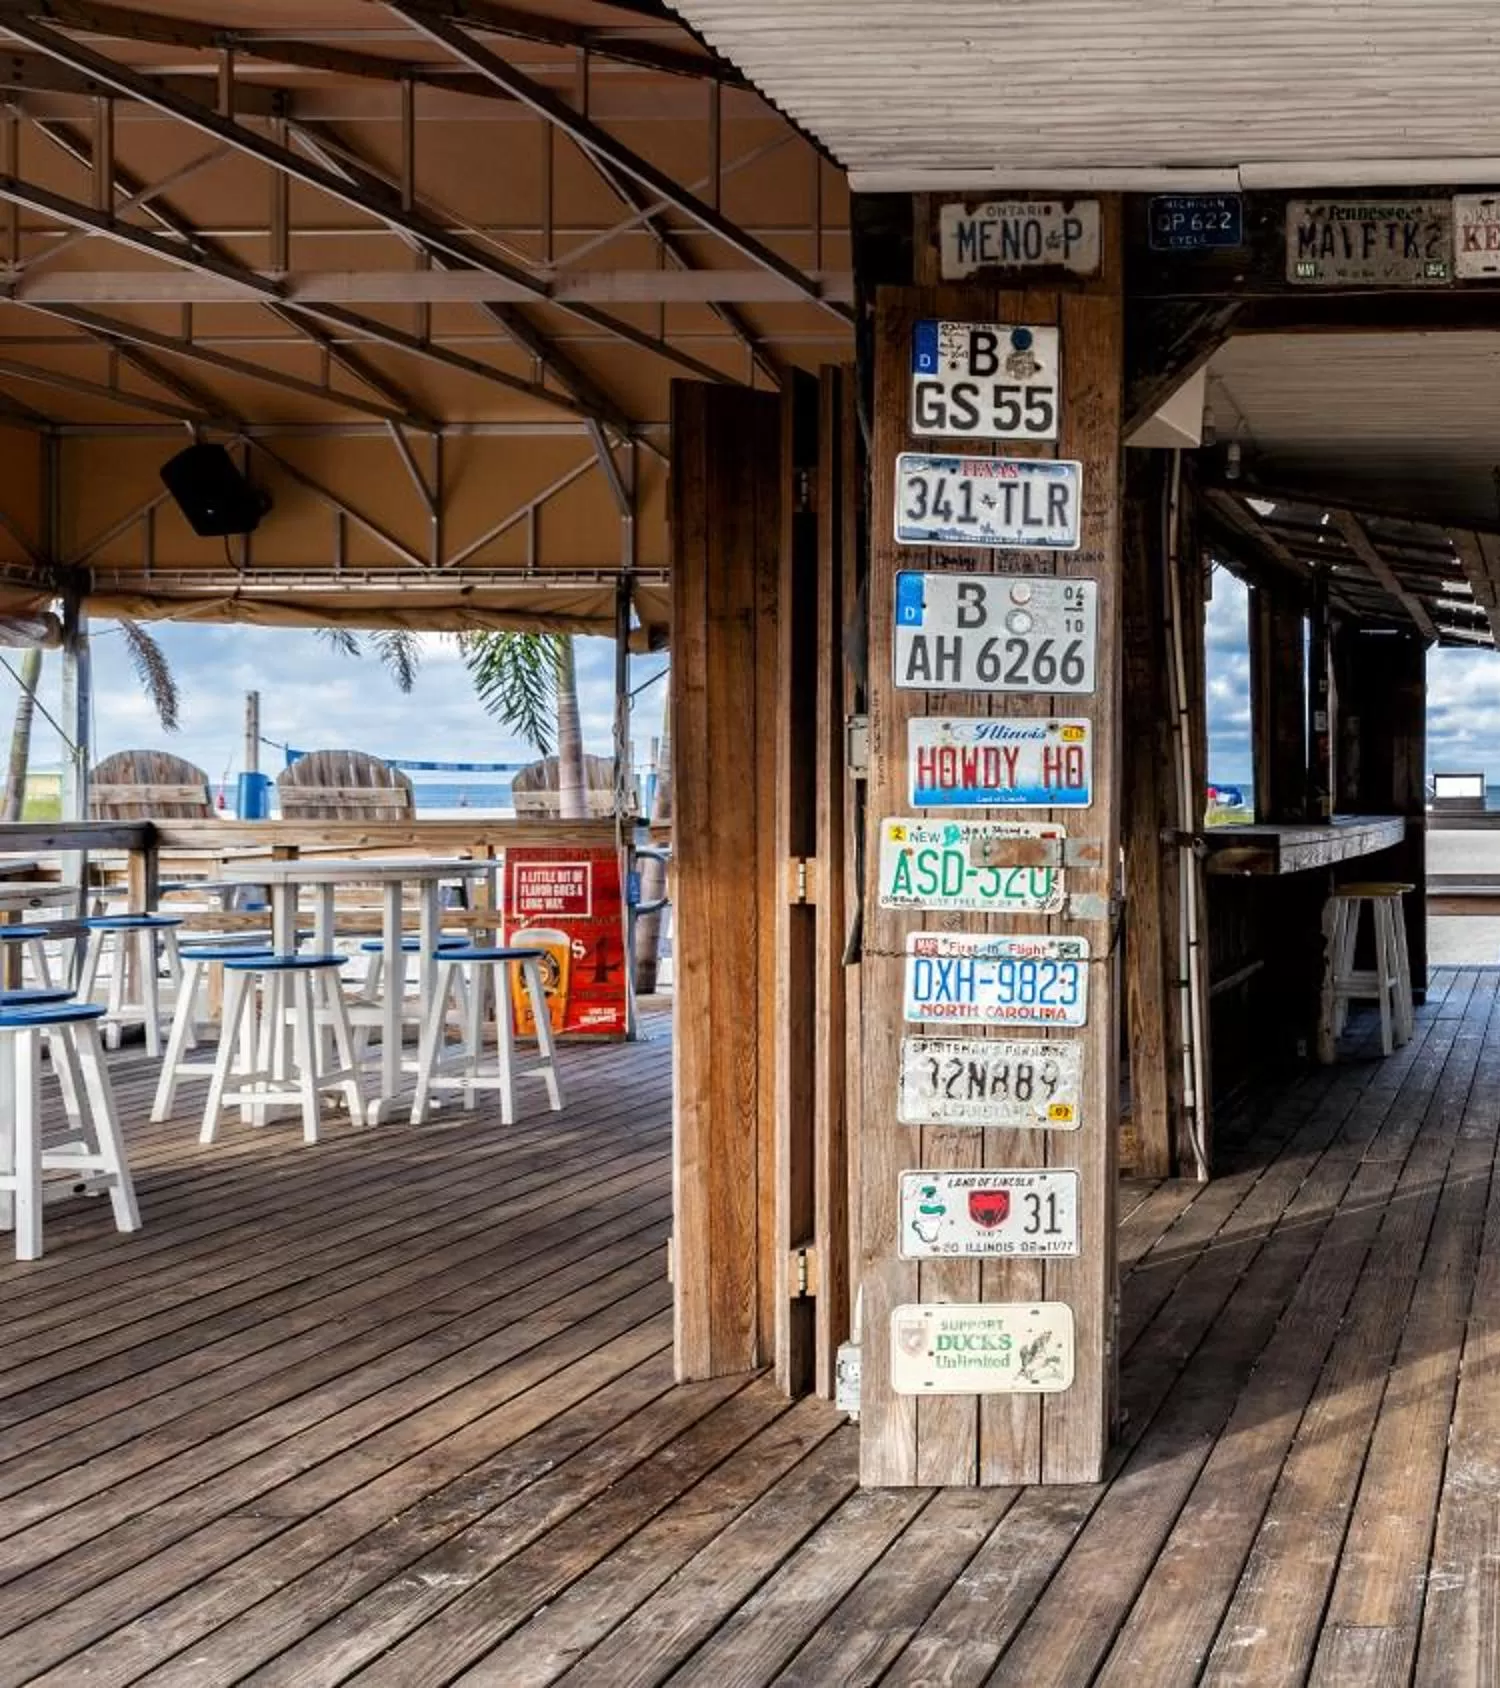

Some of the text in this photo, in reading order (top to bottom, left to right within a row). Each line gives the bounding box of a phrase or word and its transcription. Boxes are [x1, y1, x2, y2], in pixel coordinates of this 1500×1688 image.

[957, 219, 1042, 264] MENO
[919, 355, 931, 368] D
[969, 331, 999, 377] B
[915, 381, 1054, 433] GS 55
[960, 460, 1019, 479] TEXAS
[905, 477, 1069, 527] 341 TLR
[904, 607, 914, 620] D
[957, 581, 987, 629] B
[1064, 619, 1084, 633] 10
[905, 635, 1085, 685] AH 6266
[973, 722, 1047, 741] Illinois
[917, 745, 1085, 790] HOWDY HO
[909, 831, 941, 843] NEW
[519, 871, 527, 883] A
[528, 871, 556, 883] LITTLE
[520, 884, 551, 897] FLAVOR
[552, 884, 575, 897] GOES
[949, 941, 978, 953] First
[1008, 944, 1047, 957] Flight
[914, 959, 1079, 1006] DXH-9823
[919, 1004, 1067, 1021] NORTH CAROLINA
[1023, 1192, 1062, 1235] 31
[965, 1242, 1015, 1253] ILLINOIS
[940, 1319, 1004, 1332] SUPPORT
[936, 1333, 1013, 1351] DUCKS
[935, 1353, 1011, 1369] Unlimited
